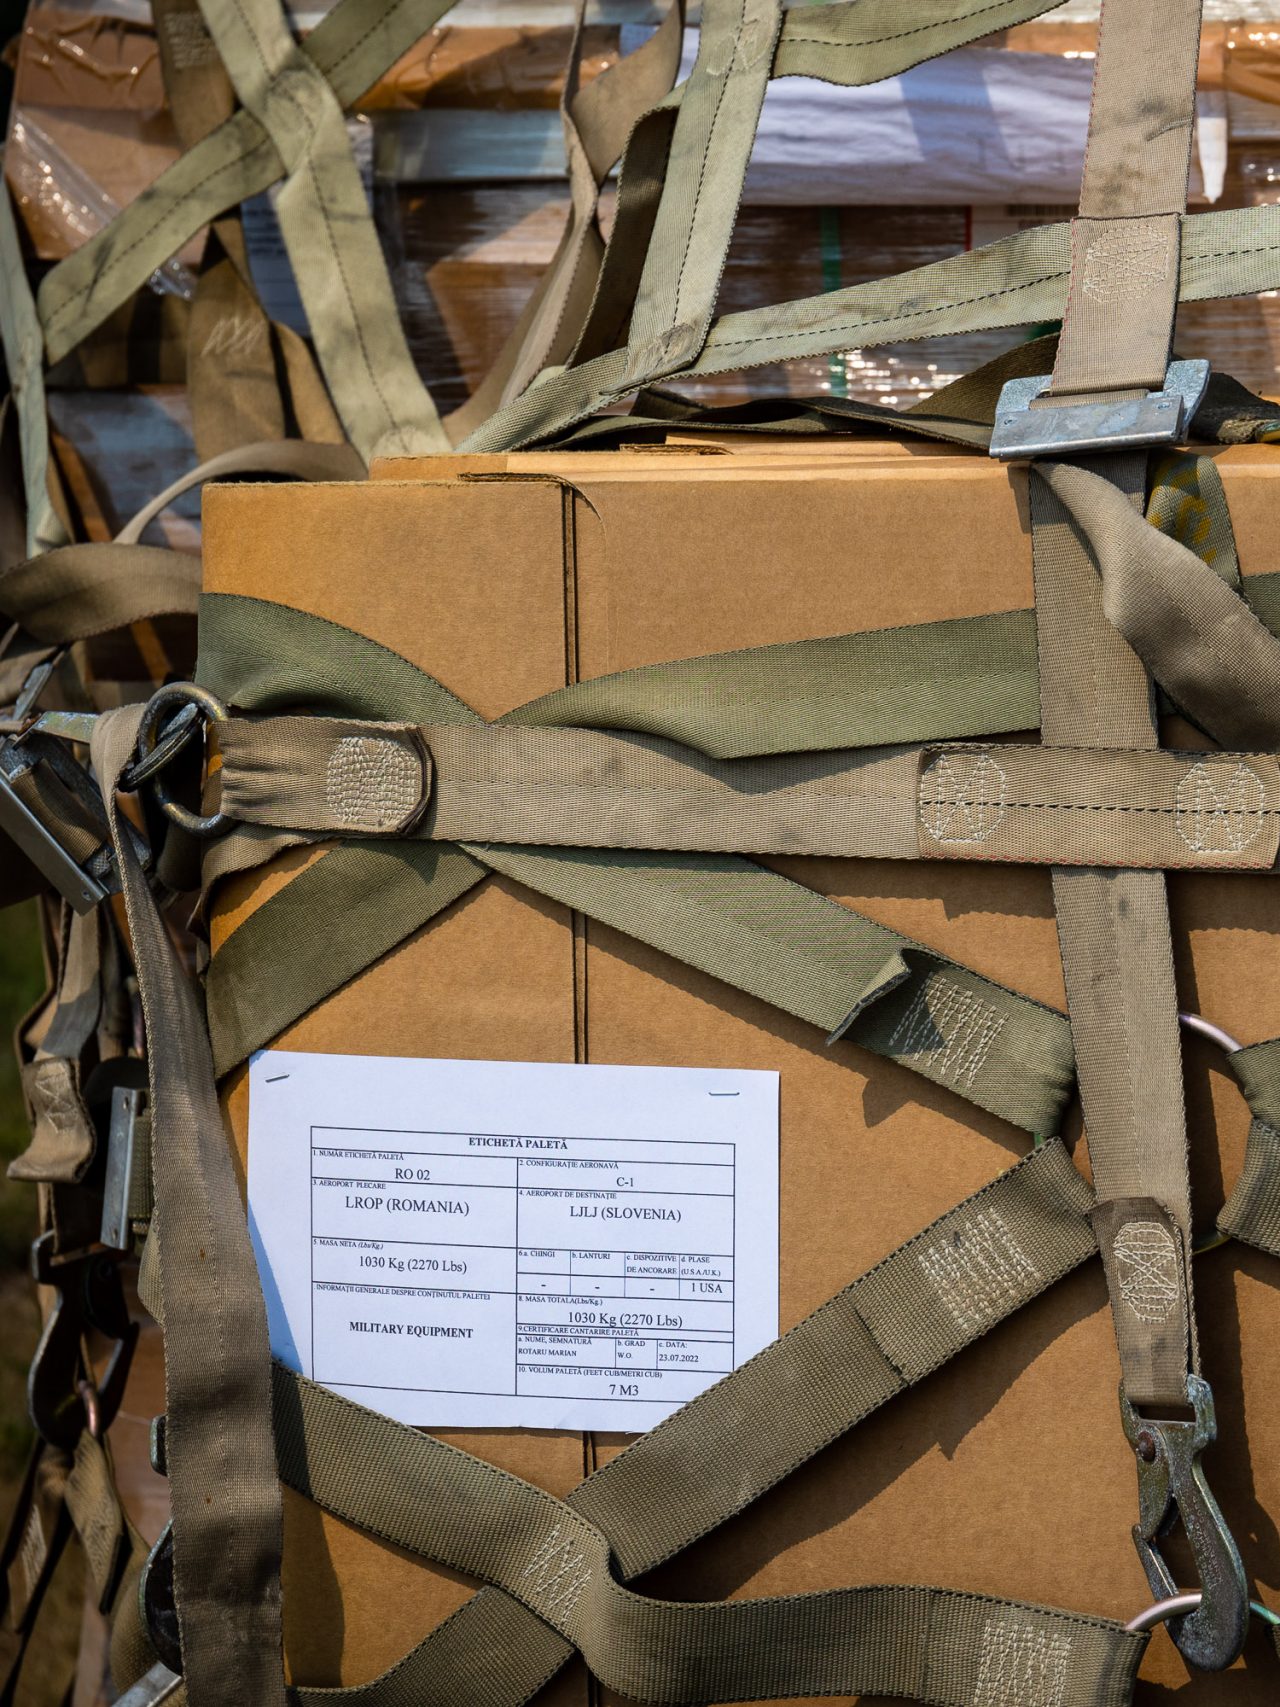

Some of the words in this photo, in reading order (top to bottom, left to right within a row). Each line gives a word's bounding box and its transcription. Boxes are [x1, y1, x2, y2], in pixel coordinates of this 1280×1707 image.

[469, 1137, 523, 1148] ETICHETĂ
[526, 1139, 568, 1150] PALETĂ
[319, 1149, 344, 1158] NUMĂR
[345, 1150, 377, 1160] ETICHETĂ
[378, 1152, 405, 1161] PALETĂ
[579, 1161, 619, 1169] AERONAVĂ
[395, 1168, 414, 1180] RO
[416, 1169, 430, 1181] 02
[319, 1180, 353, 1188] AEROPORT
[356, 1181, 386, 1190] PLECARE
[616, 1177, 634, 1187] C-1
[526, 1190, 563, 1198] AEROPORT
[345, 1196, 383, 1210] LROP
[386, 1198, 470, 1217] (ROMANIA)
[570, 1206, 598, 1219] LJLJ
[601, 1207, 682, 1223] (SLOVENIA)
[319, 1239, 338, 1247] MASA
[339, 1240, 357, 1248] NETA
[530, 1250, 555, 1258] CHINGI
[634, 1254, 677, 1262] DISPOZITIVE
[359, 1255, 385, 1268] 1030
[388, 1257, 405, 1272] Kg
[407, 1258, 439, 1272] (2270
[442, 1260, 468, 1274] Lbs)
[355, 1286, 390, 1295] GENERALE
[391, 1288, 416, 1296] DESPRE
[462, 1292, 490, 1300] PALETEI
[699, 1283, 723, 1293] USA
[568, 1312, 596, 1323] 1030
[599, 1313, 617, 1327] Kg
[620, 1314, 653, 1327] (2270
[656, 1315, 683, 1328] Lbs)
[349, 1321, 404, 1335] MILITARY
[407, 1325, 474, 1339] EQUIPMENT
[570, 1327, 610, 1335] CANTARIRE
[611, 1328, 639, 1337] PALETĂ
[525, 1336, 548, 1344] NUME,
[518, 1348, 547, 1356] ROTARU
[548, 1349, 577, 1357] MARIAN
[659, 1354, 699, 1363] 23.07.2022
[528, 1366, 554, 1374] VOLUM
[555, 1366, 582, 1375] PALETĂ
[583, 1368, 603, 1377] (FEET
[645, 1371, 662, 1379] CUB)
[609, 1384, 616, 1395] 7
[619, 1385, 639, 1396] M3
